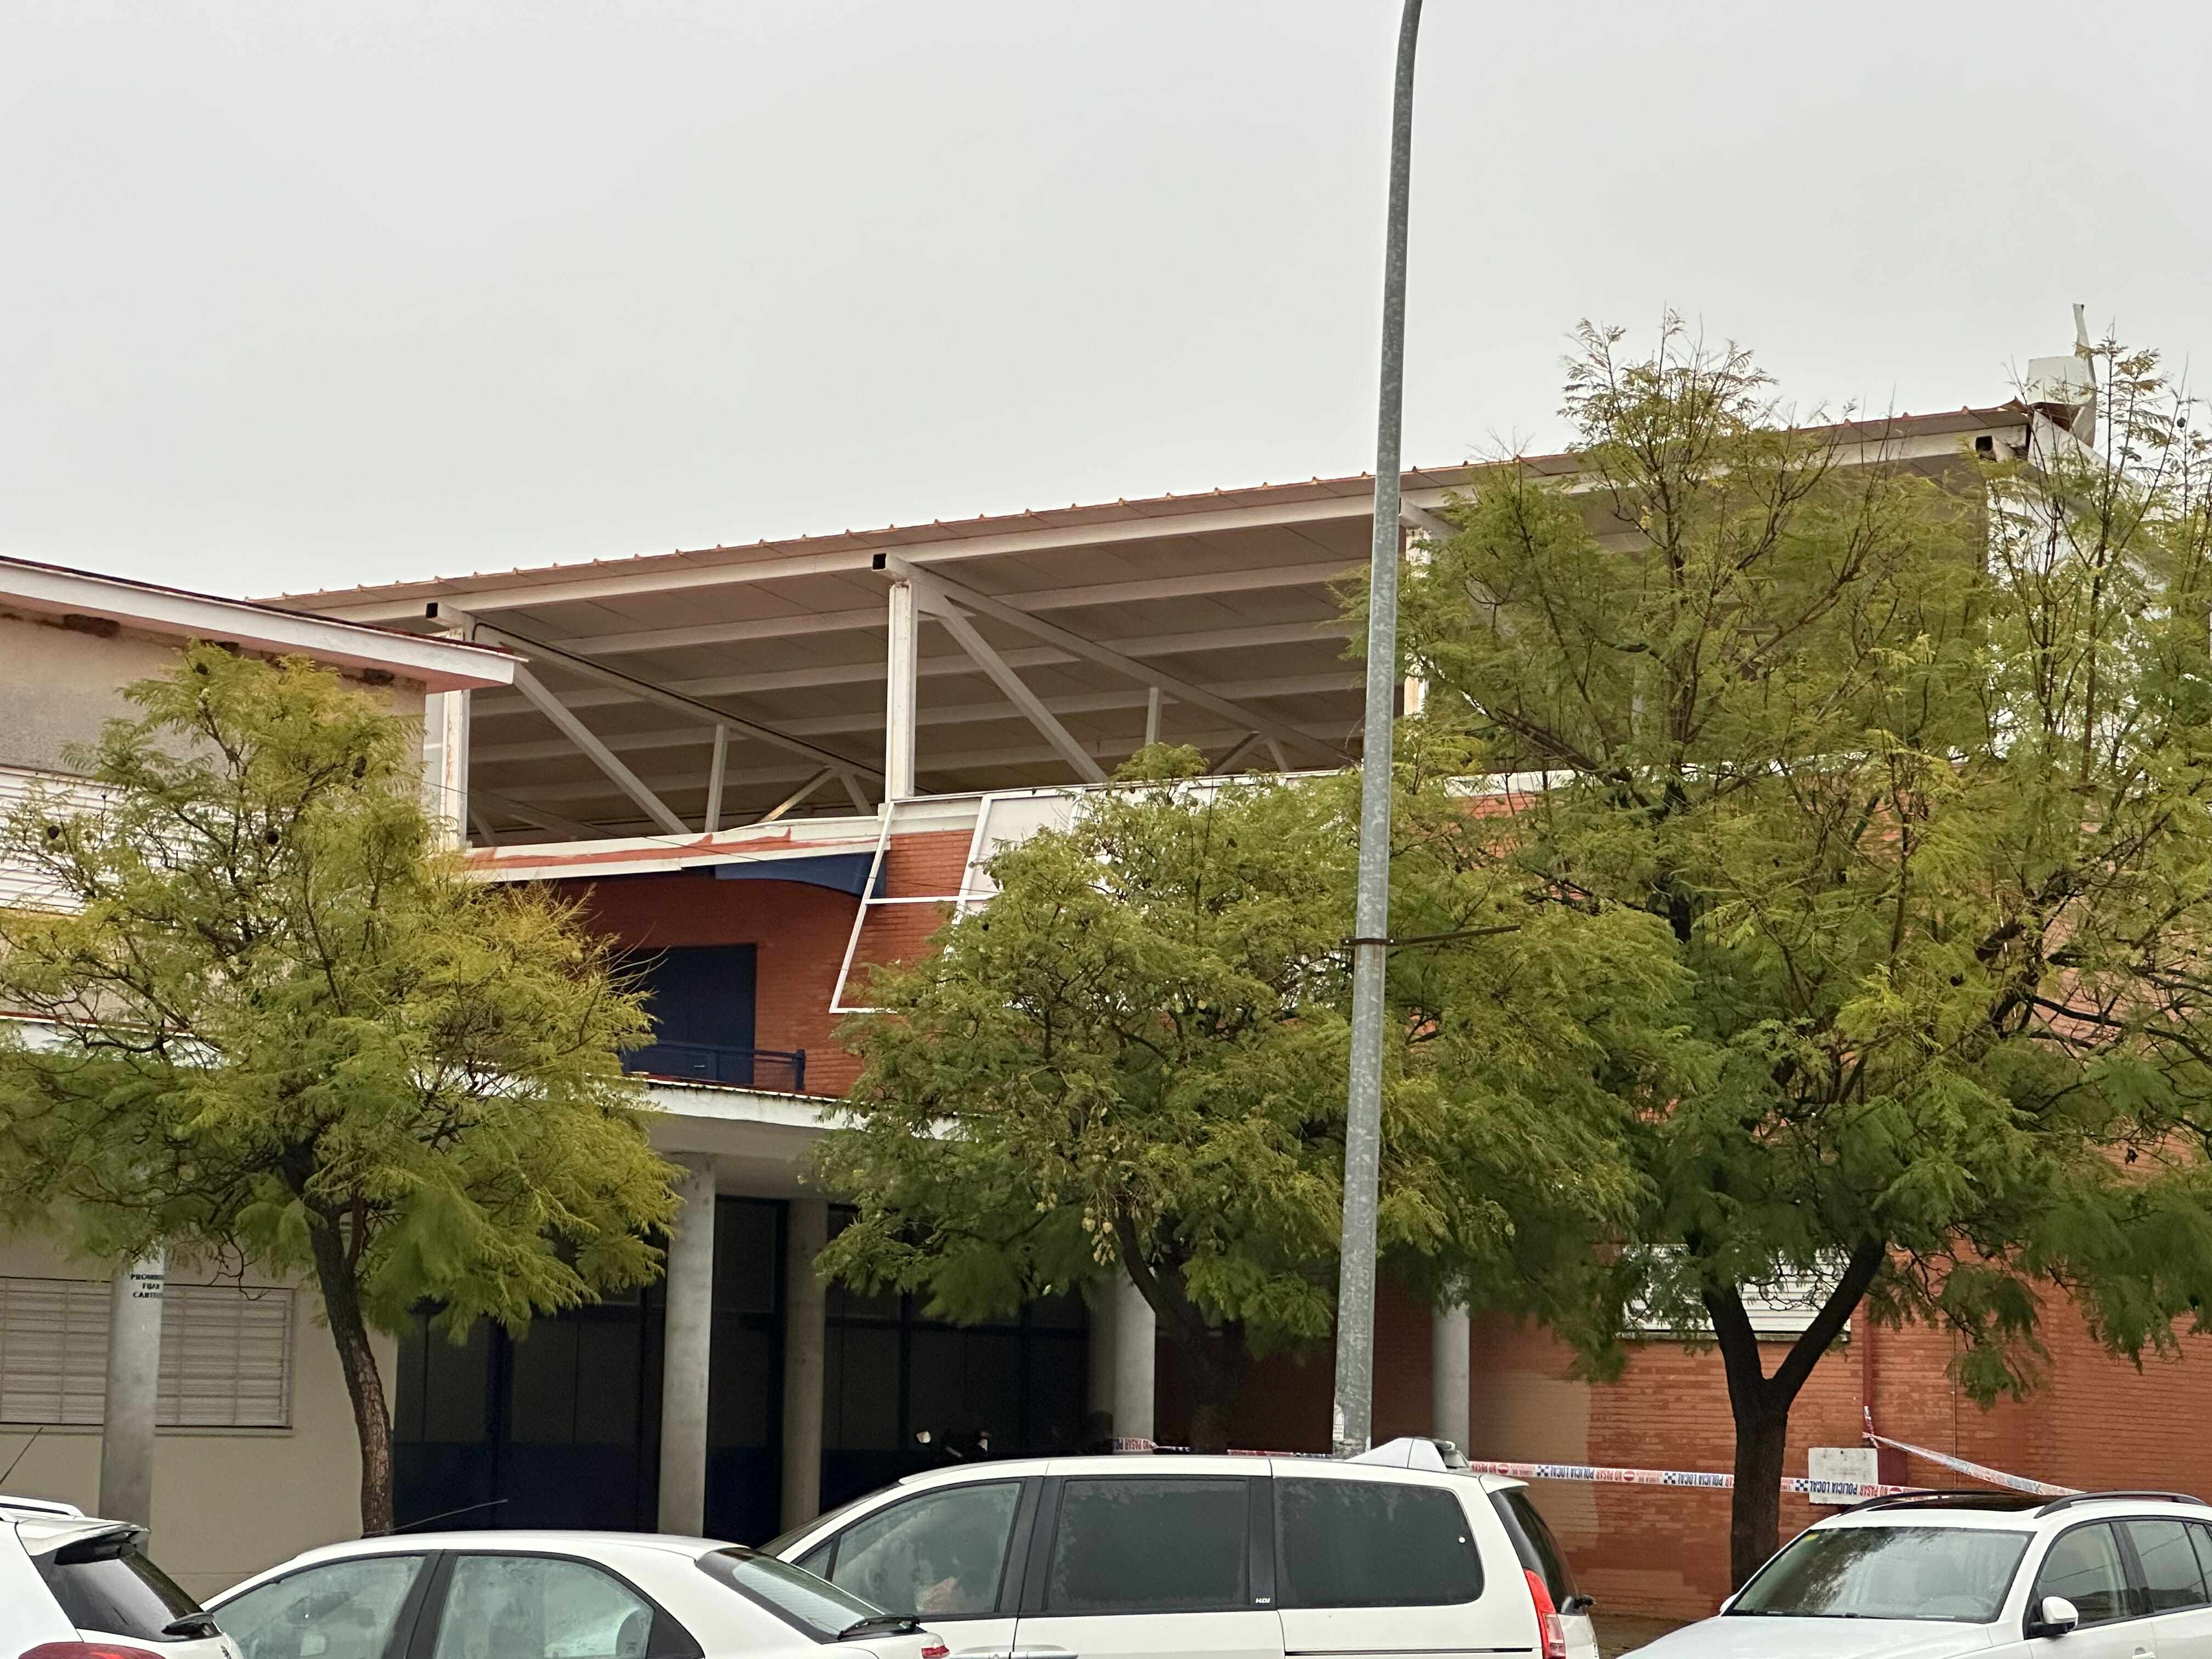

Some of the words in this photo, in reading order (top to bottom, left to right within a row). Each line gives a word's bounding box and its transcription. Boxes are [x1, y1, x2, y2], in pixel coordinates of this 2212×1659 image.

[1551, 1466, 1569, 1478] LOCAL
[1571, 1468, 1594, 1480] POLICIA
[1596, 1469, 1613, 1480] PASAR
[1615, 1470, 1622, 1480] NO
[1678, 1473, 1697, 1485] LOCAL
[1699, 1474, 1724, 1486] POLICIA
[1810, 1480, 1830, 1493] LOCAL
[1832, 1482, 1858, 1495] POLICIA
[1860, 1485, 1878, 1497] PASAR
[1880, 1486, 1888, 1497] NO
